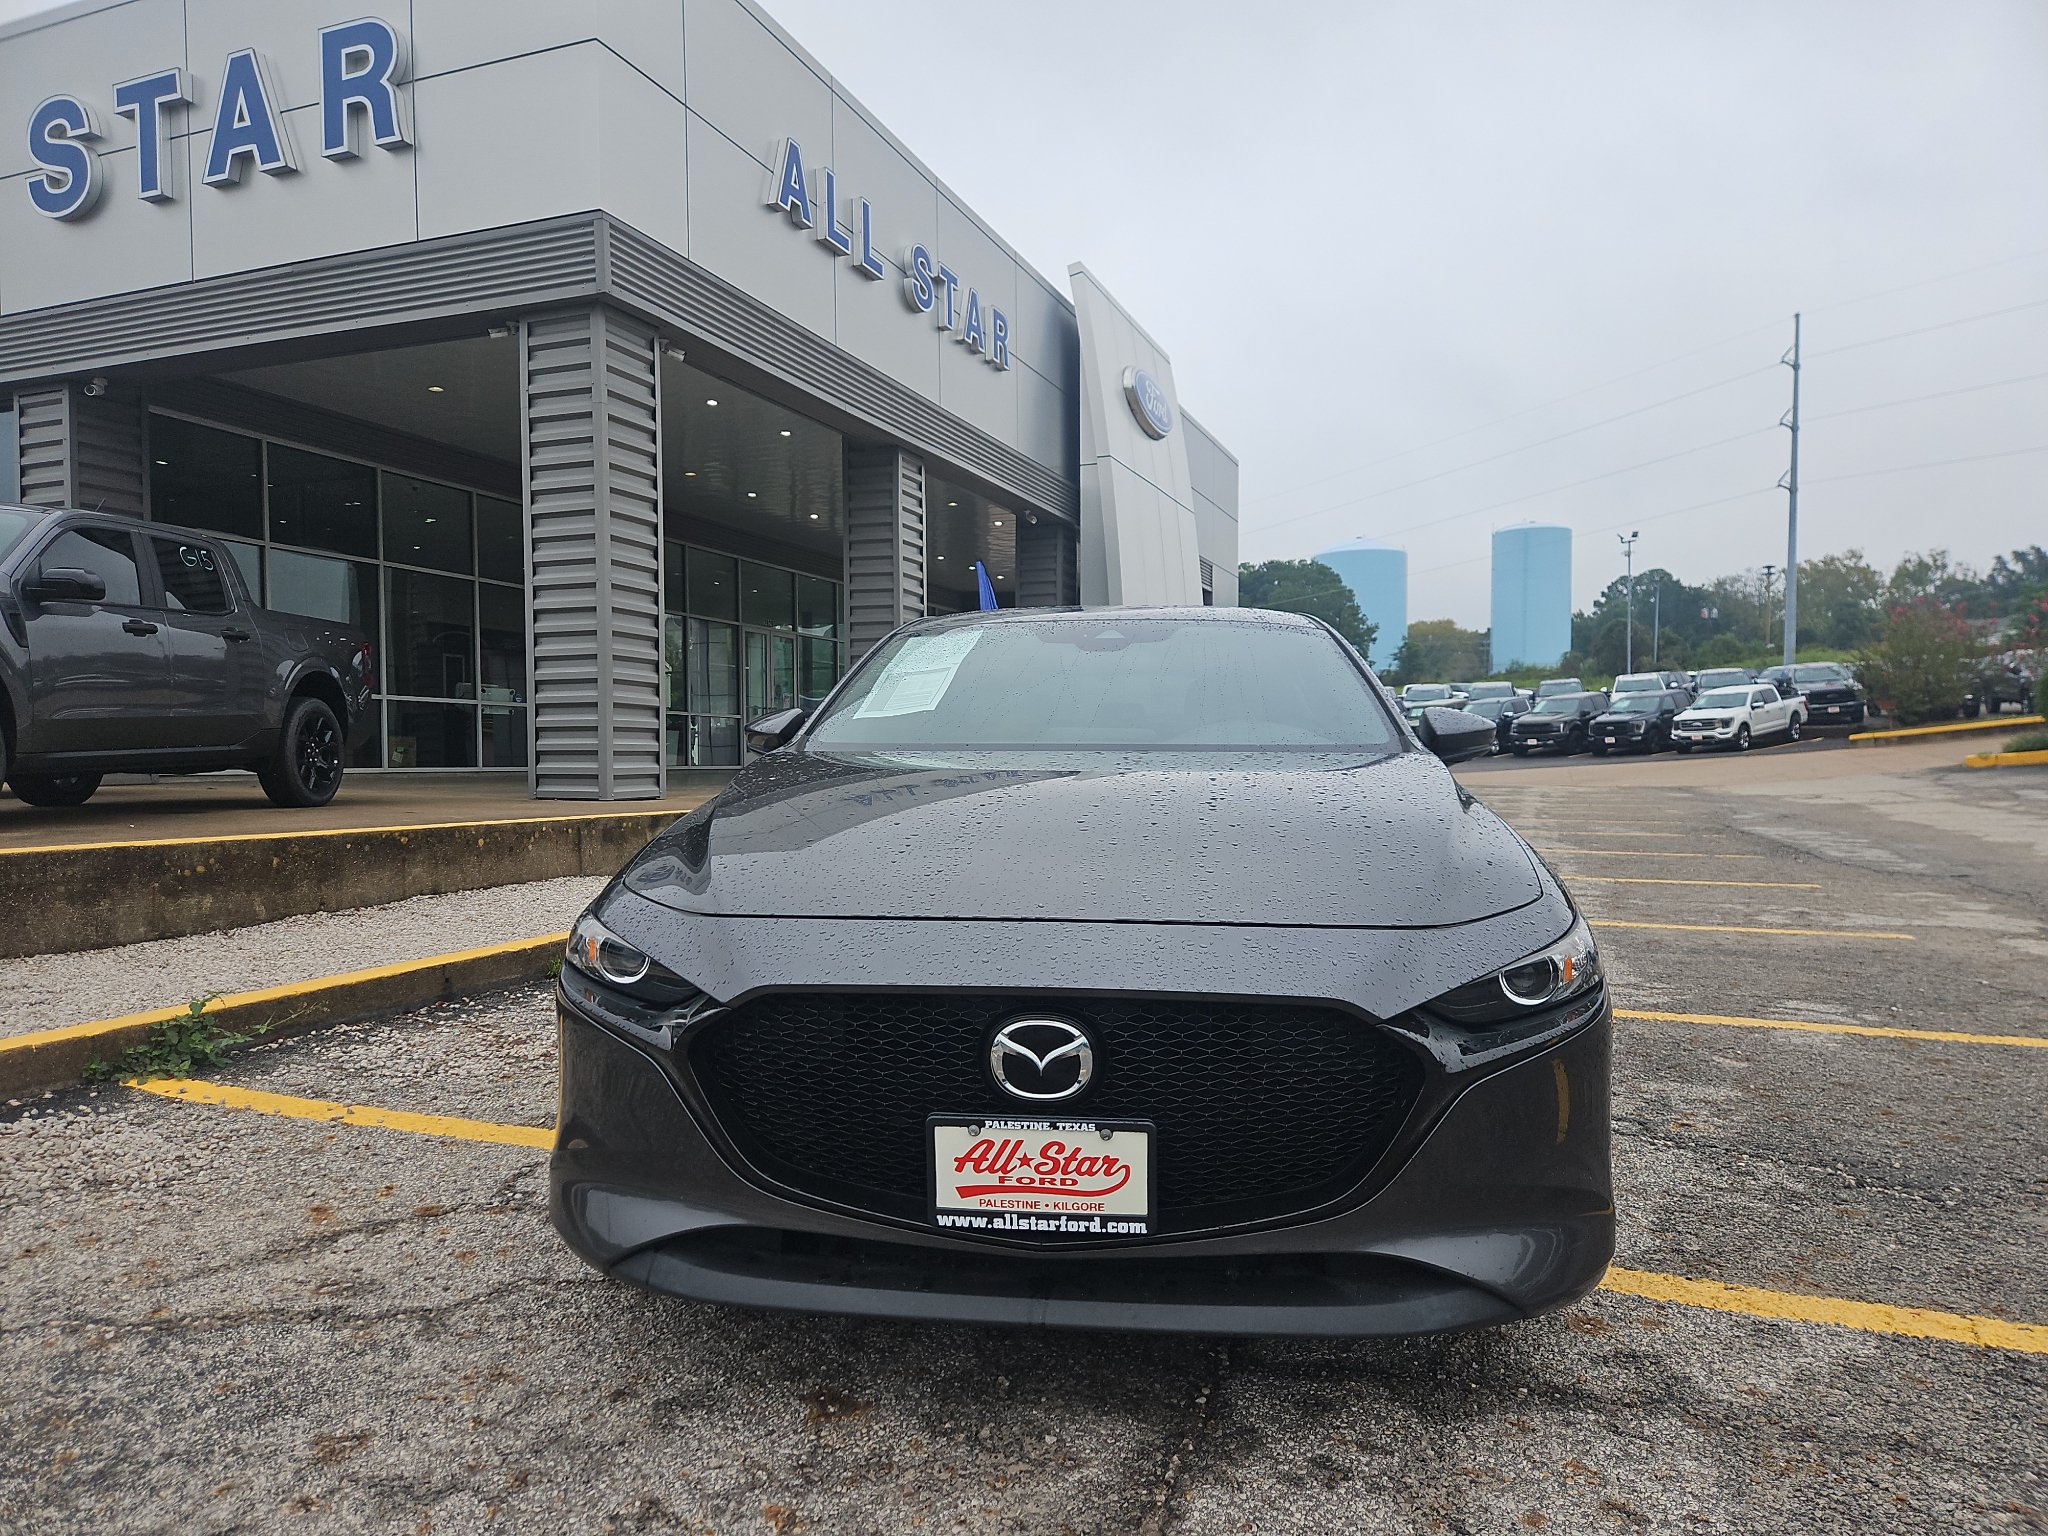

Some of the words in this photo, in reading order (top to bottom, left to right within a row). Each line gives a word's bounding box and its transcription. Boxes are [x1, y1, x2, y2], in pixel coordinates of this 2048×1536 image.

[26, 16, 413, 222] STAR
[765, 137, 885, 281] ALL
[903, 243, 1011, 371] STAR
[1057, 1122, 1096, 1132] TEXAS
[998, 1175, 1079, 1186] FORD
[979, 1198, 1041, 1210] PALESTINE
[1053, 1201, 1105, 1212] KILGORE
[936, 1214, 1148, 1234] www.allstarford.com
